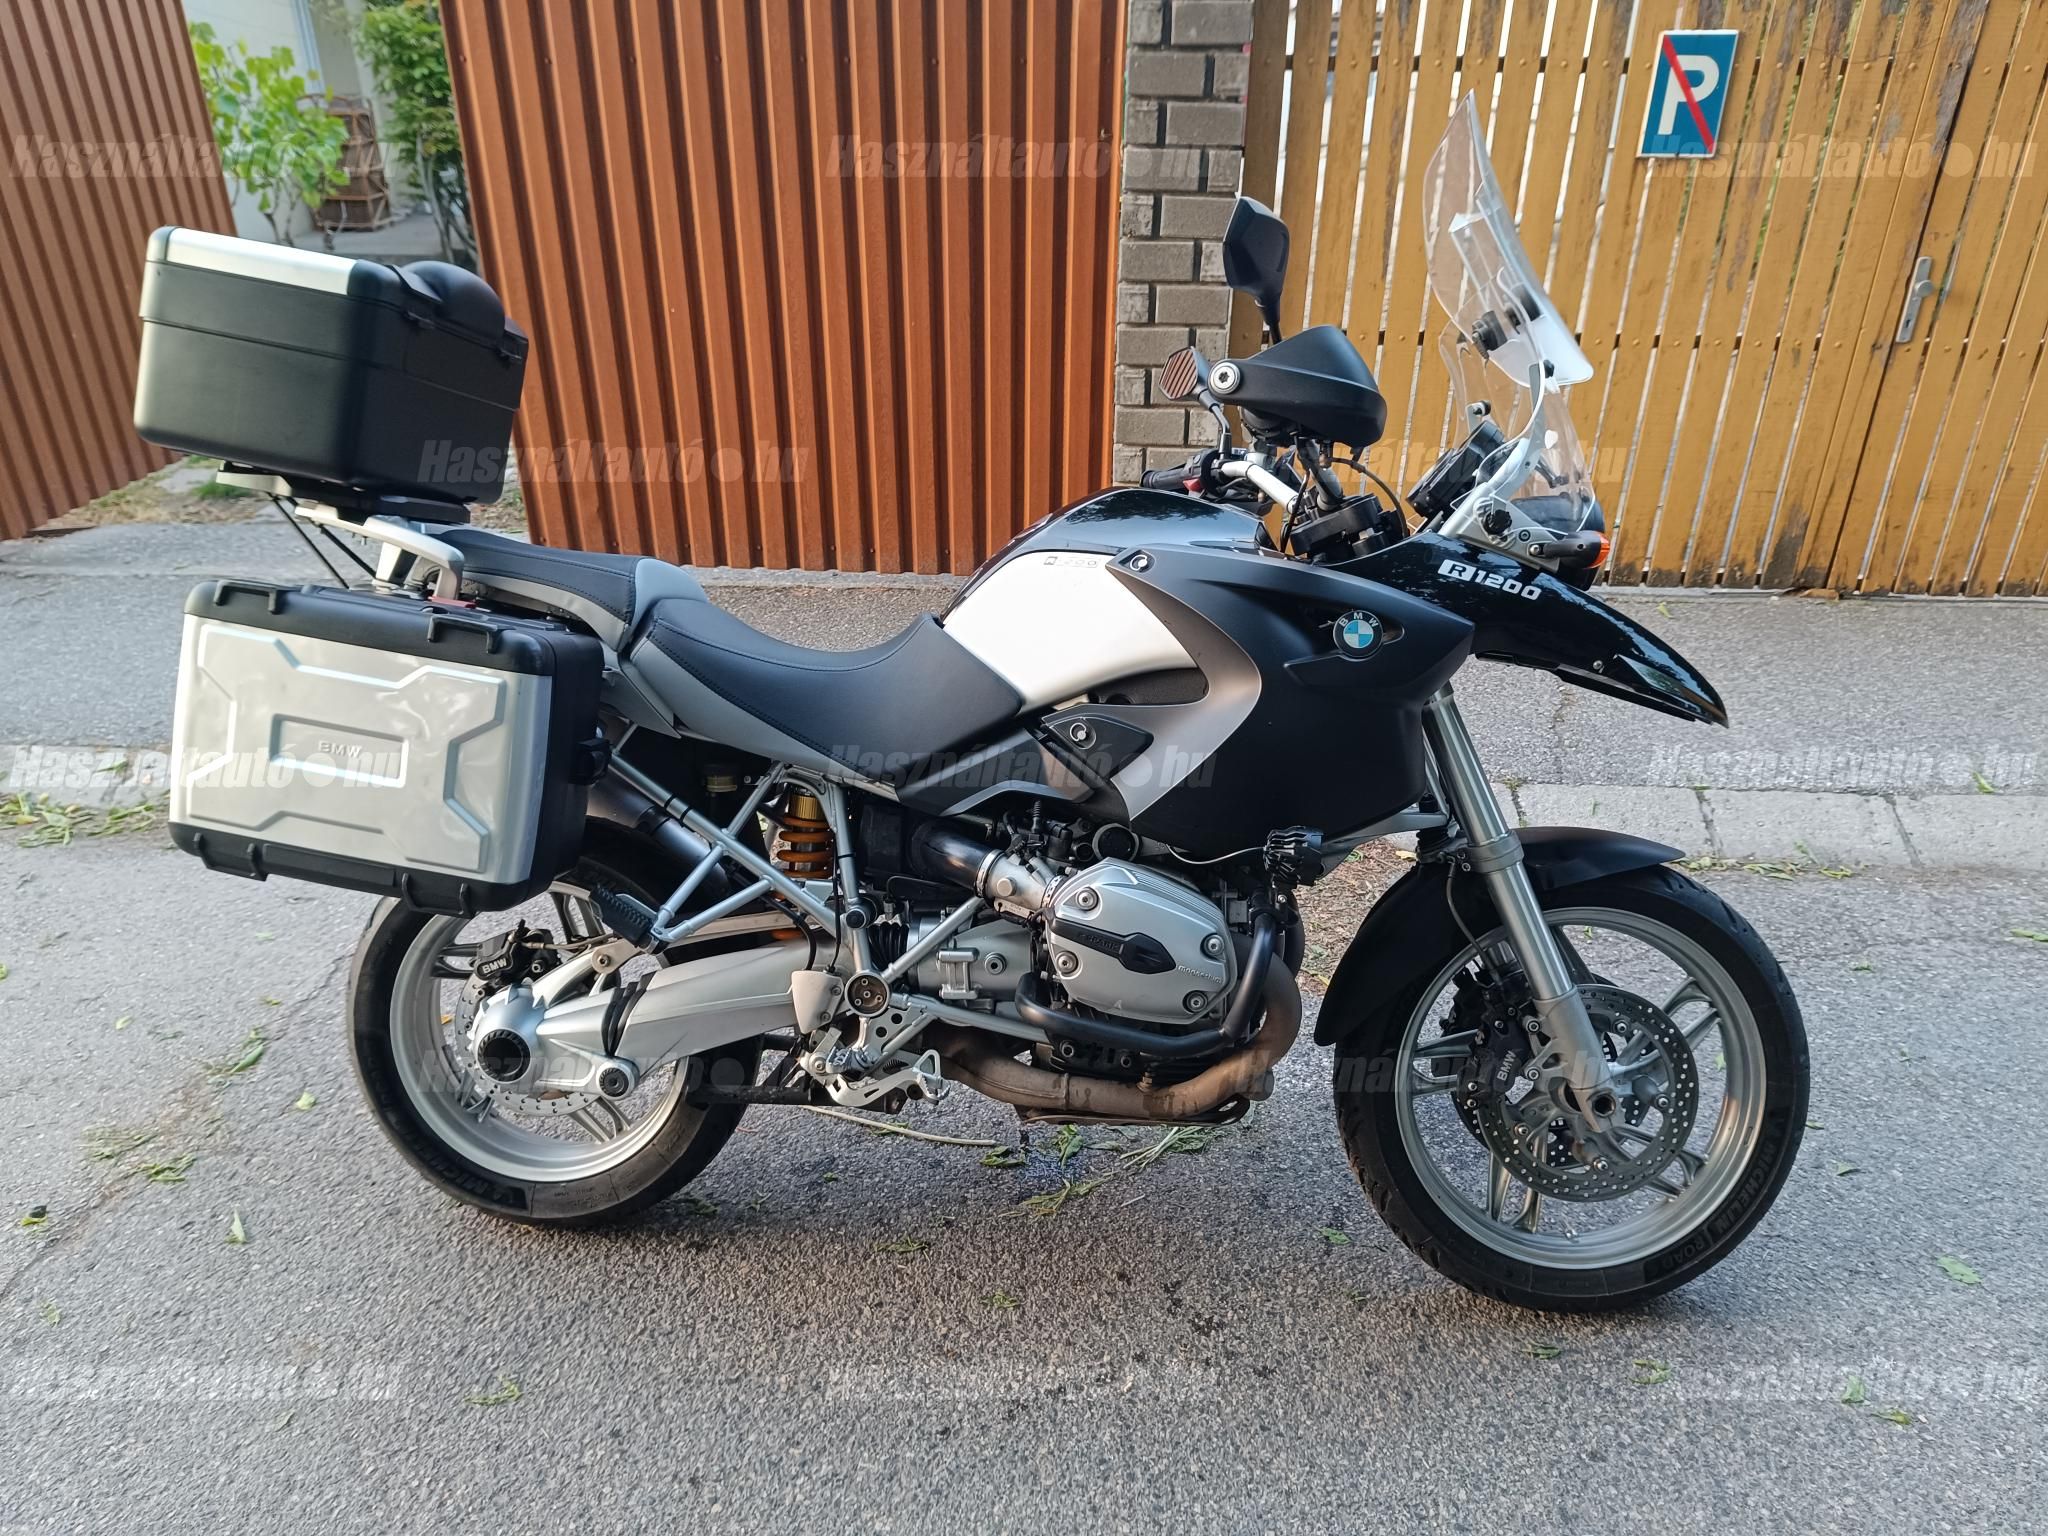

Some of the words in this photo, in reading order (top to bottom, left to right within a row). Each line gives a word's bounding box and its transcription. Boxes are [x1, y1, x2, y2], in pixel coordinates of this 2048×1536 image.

[1657, 55, 1719, 135] P
[1338, 611, 1379, 627] BMW
[319, 740, 362, 758] BMW
[481, 958, 508, 974] BMW
[1496, 1050, 1517, 1082] BMW
